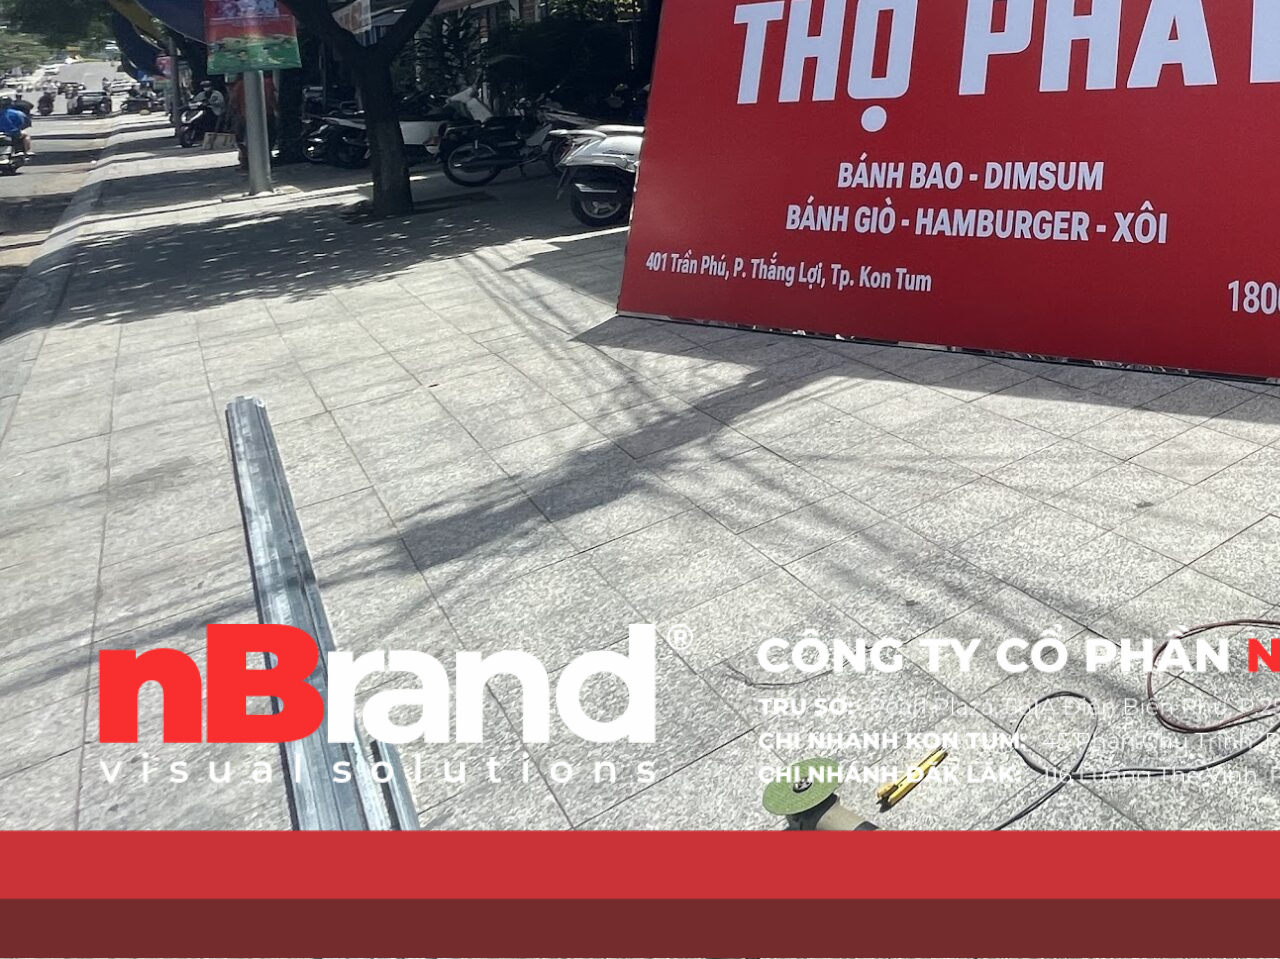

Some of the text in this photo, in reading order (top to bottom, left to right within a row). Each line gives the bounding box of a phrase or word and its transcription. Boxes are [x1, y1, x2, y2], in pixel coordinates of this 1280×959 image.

[838, 152, 904, 190] BÁNH
[909, 161, 963, 191] BAO
[984, 161, 1106, 192] DIMSUM
[786, 195, 849, 233] BÁNH
[854, 196, 897, 235] GIÒ
[915, 207, 1091, 242] HAMBURGER
[1112, 200, 1169, 245] XÔI
[645, 249, 932, 293] 401 Trần Phú, P. Thắng Lợi, Tp. Kon Tum
